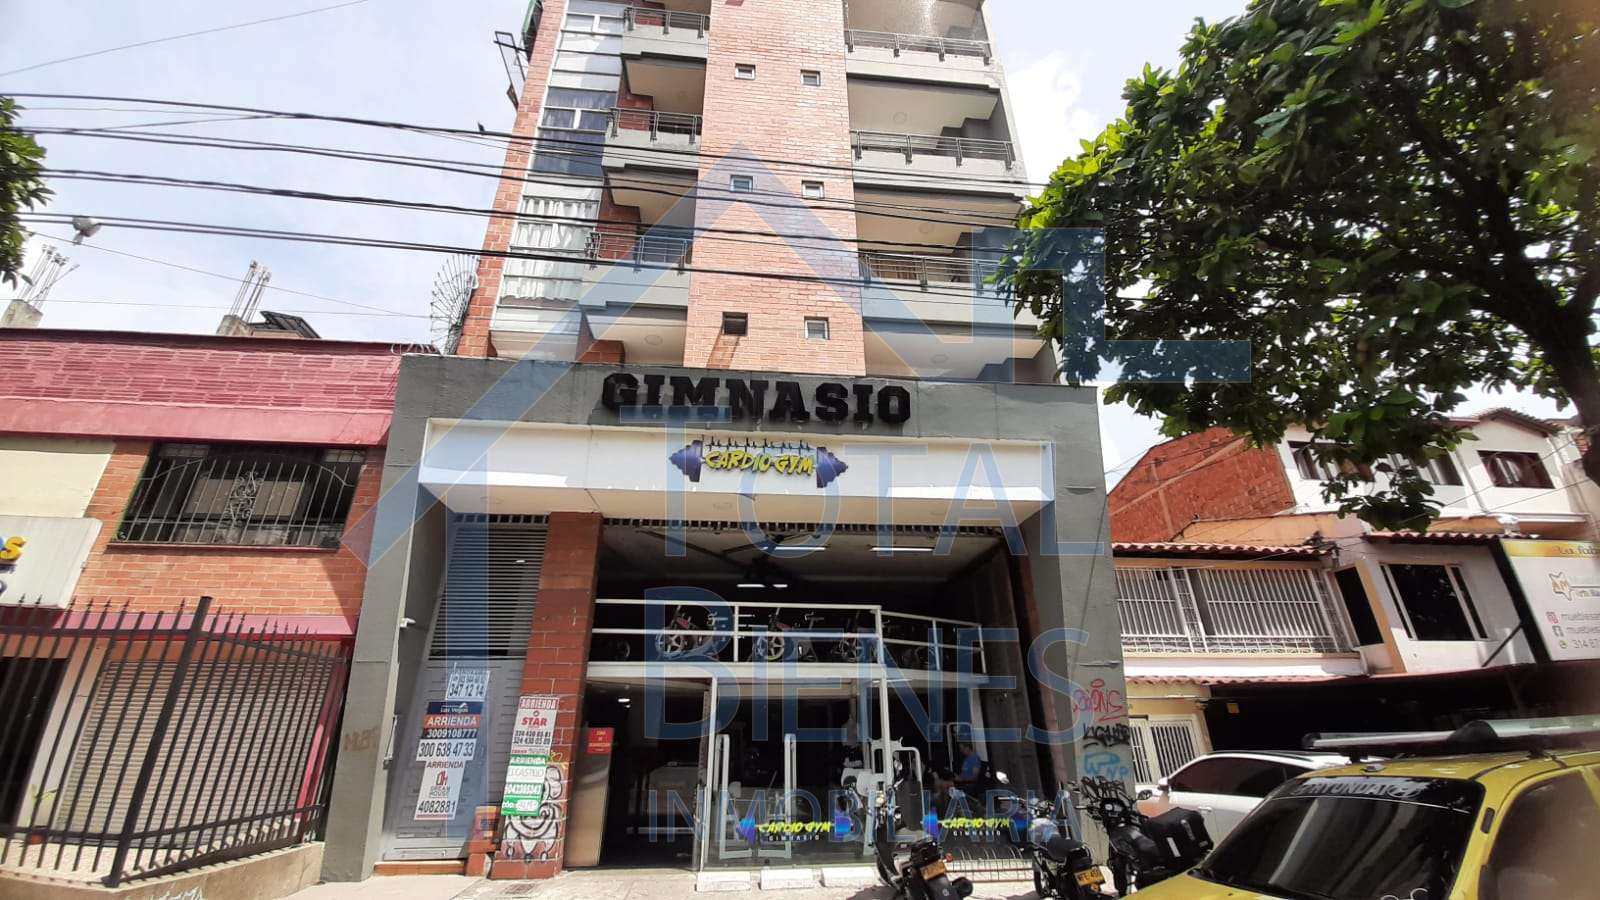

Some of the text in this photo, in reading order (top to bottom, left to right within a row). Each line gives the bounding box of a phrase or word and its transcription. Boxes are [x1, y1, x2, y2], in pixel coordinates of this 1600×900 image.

[602, 373, 911, 425] GIMNASIO
[705, 451, 815, 476] CARDIO GYM
[450, 683, 485, 698] 347 12 14
[520, 699, 557, 709] ARRIENDA
[427, 716, 477, 726] ARRIENDA
[521, 717, 548, 726] STAR
[427, 729, 477, 738] 3009108777
[419, 742, 474, 757] 300 638 47 33
[419, 800, 456, 813] 4082881
[758, 821, 832, 833] CARDIO GYM
